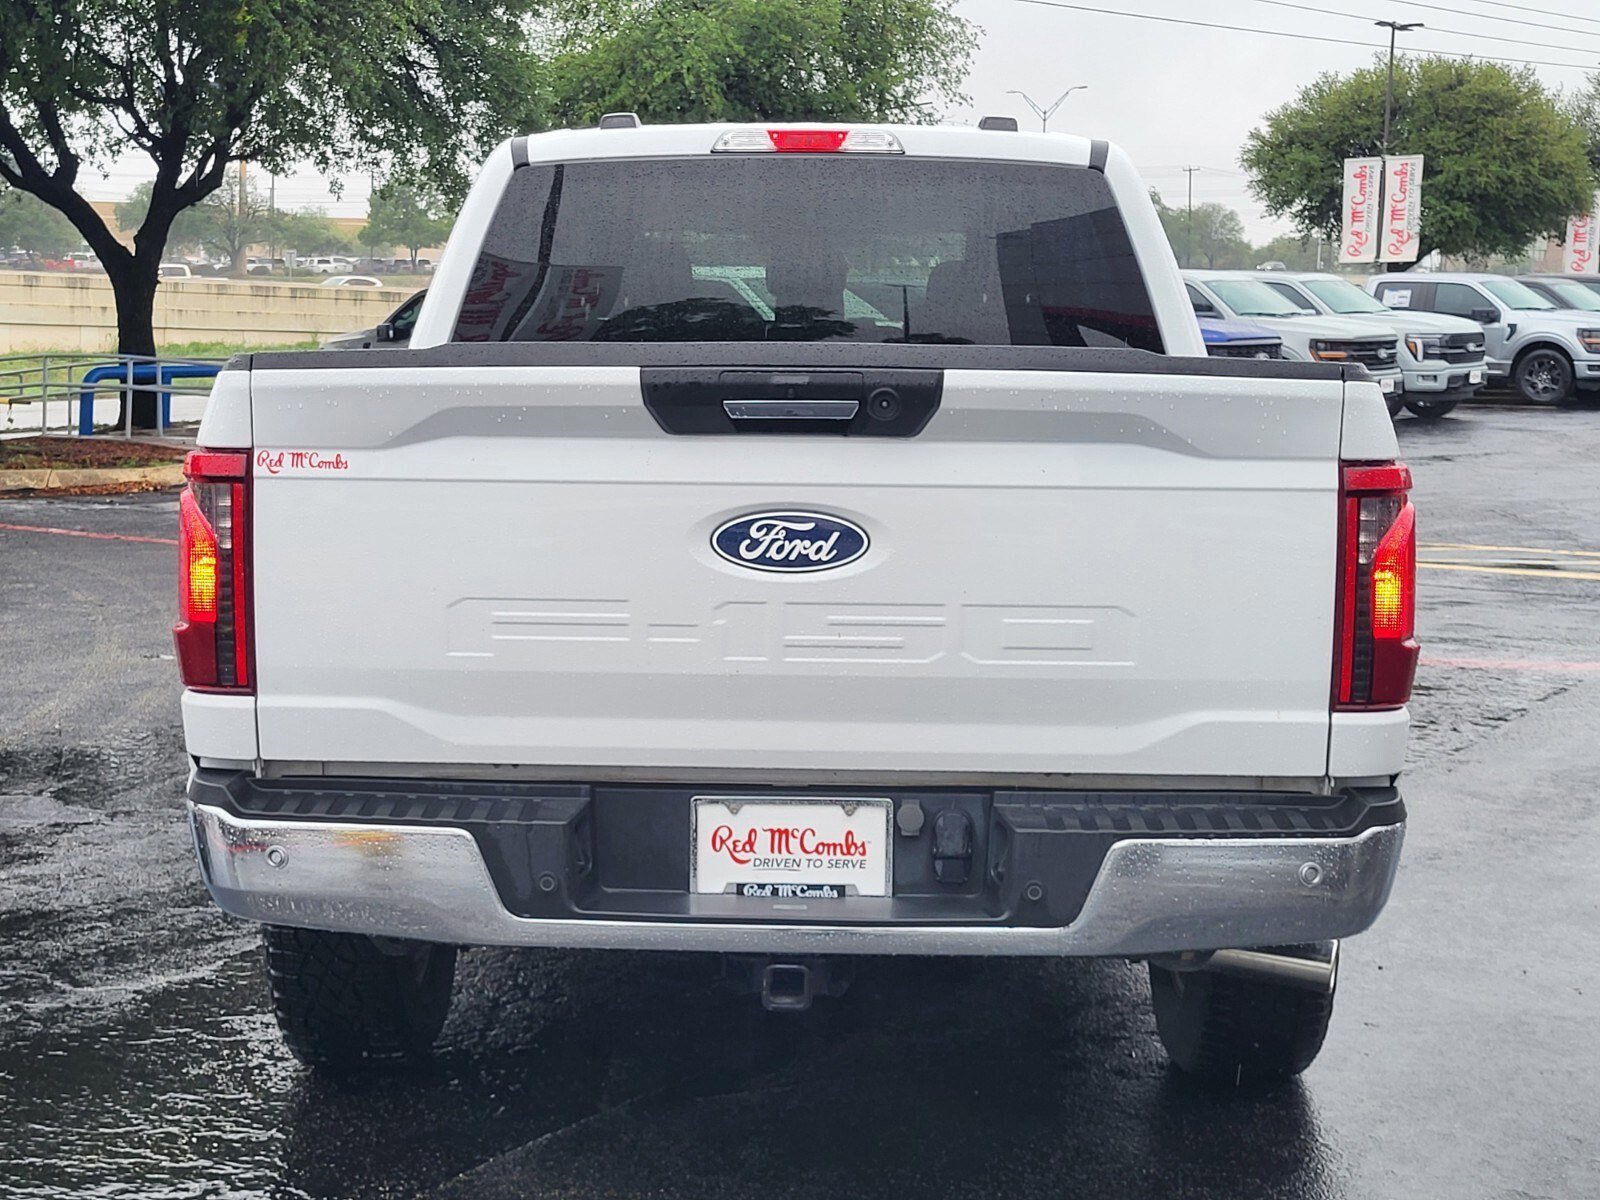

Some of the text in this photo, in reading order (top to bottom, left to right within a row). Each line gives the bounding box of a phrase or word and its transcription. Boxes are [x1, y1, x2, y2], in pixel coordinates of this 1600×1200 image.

[1350, 165, 1368, 227] McCombs
[1390, 162, 1409, 226] McCombs
[257, 450, 349, 474] Red McCombs
[738, 519, 841, 562] Ford
[711, 825, 867, 865] Red McCombs
[753, 857, 868, 870] DRIVEN TO SERVE
[742, 883, 839, 899] Red McCombs
